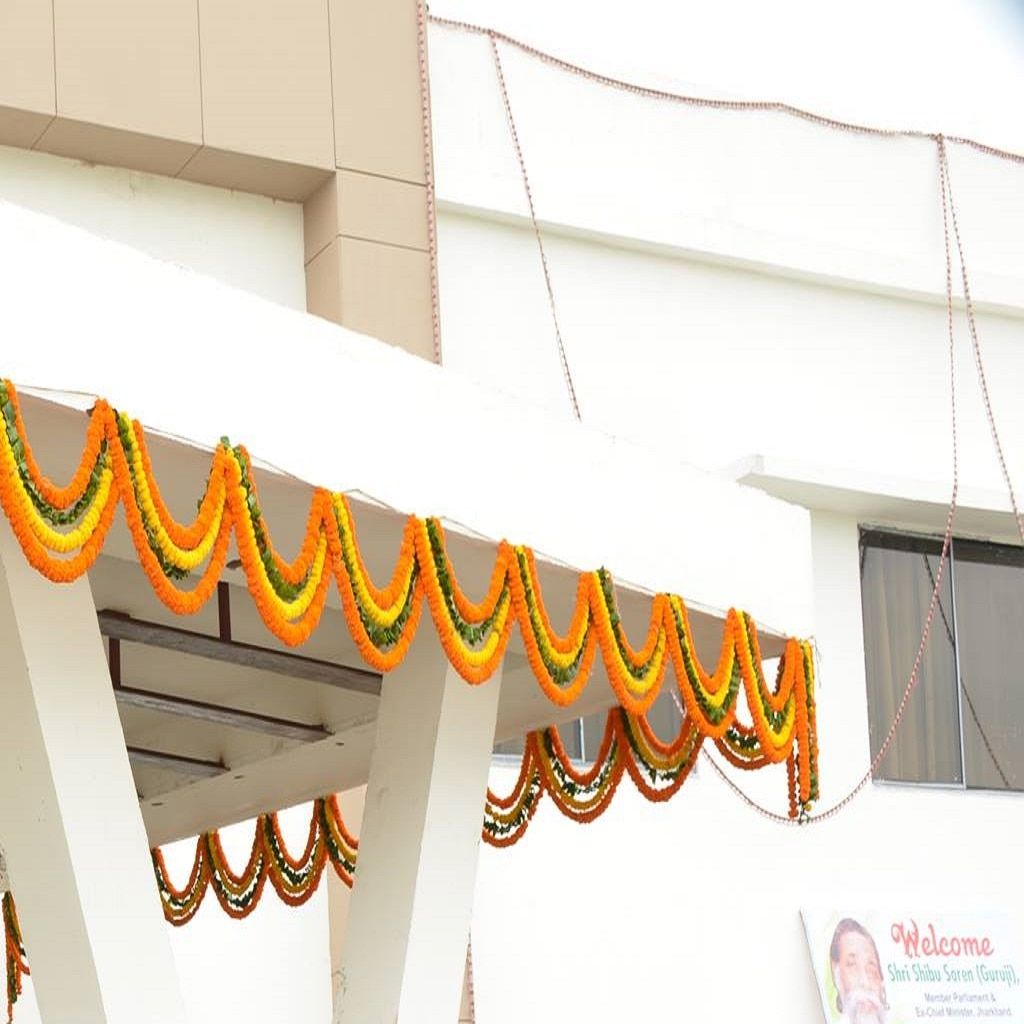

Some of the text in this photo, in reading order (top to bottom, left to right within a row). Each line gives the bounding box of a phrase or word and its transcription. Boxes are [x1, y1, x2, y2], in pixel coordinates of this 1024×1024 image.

[890, 918, 994, 959] Welcome
[887, 961, 911, 982] Shri
[911, 961, 941, 982] Shibu
[943, 963, 974, 982] Soren
